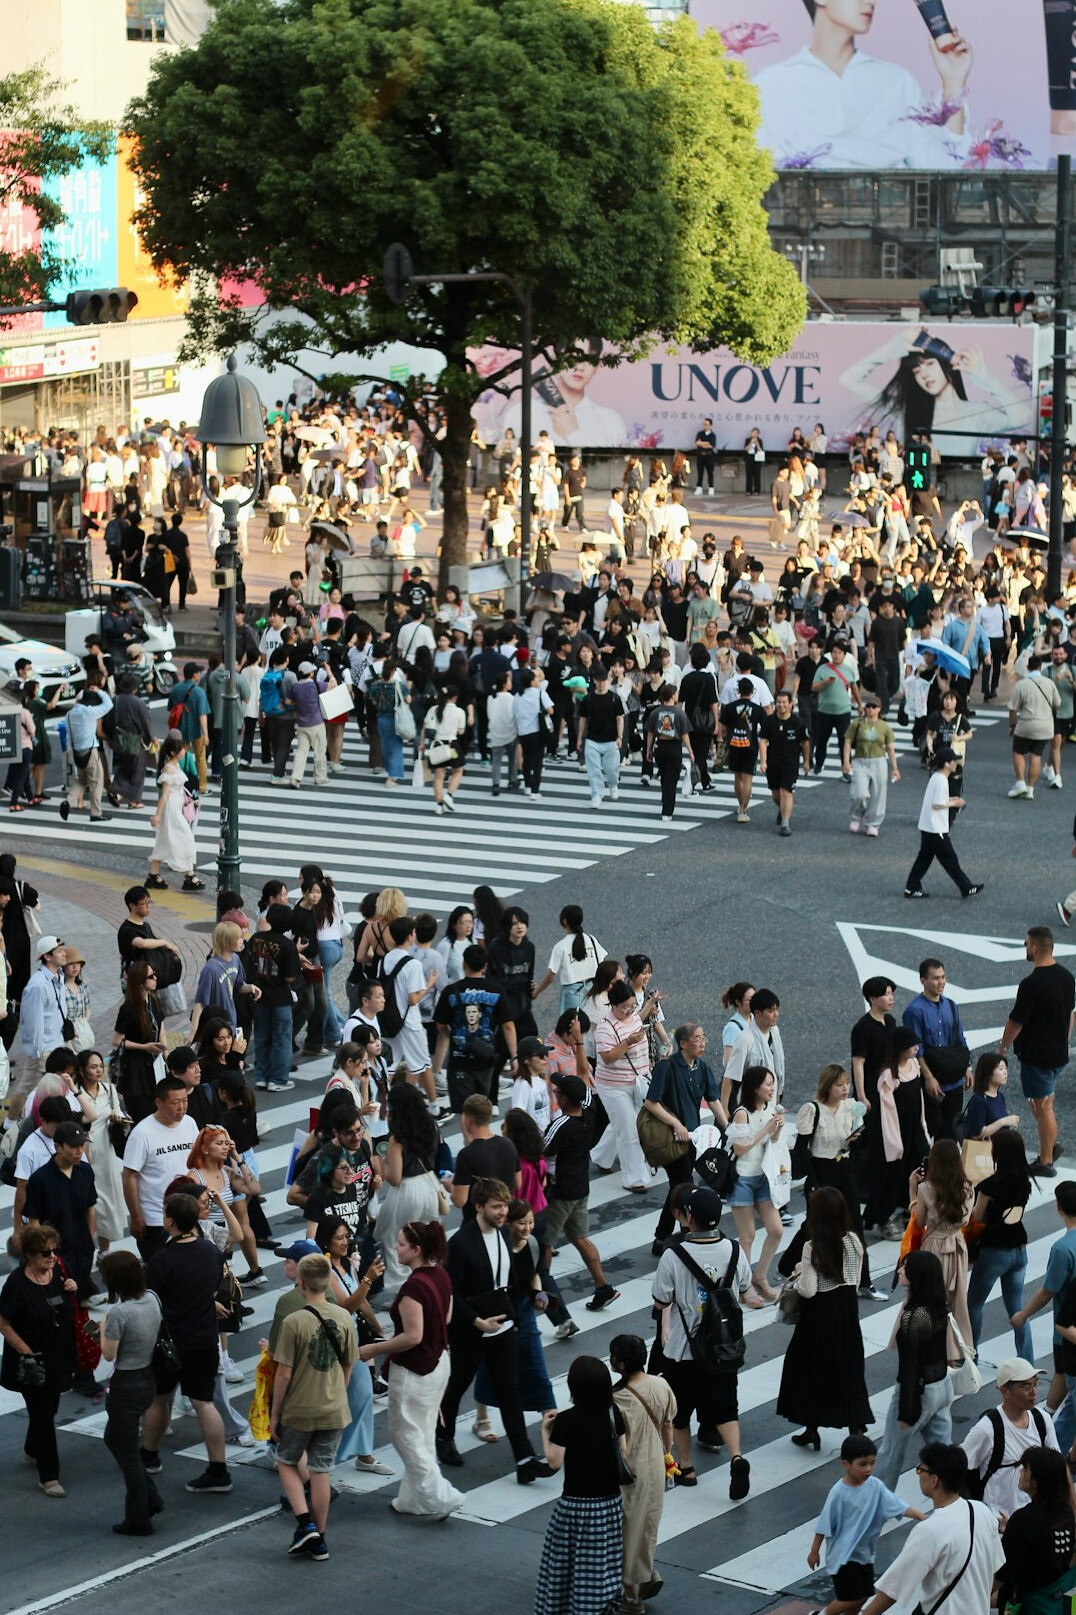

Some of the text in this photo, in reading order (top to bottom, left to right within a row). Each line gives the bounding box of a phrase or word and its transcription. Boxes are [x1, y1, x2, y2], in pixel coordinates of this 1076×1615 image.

[649, 362, 821, 404] UNOVE
[156, 1142, 193, 1156] JIL SANDE
